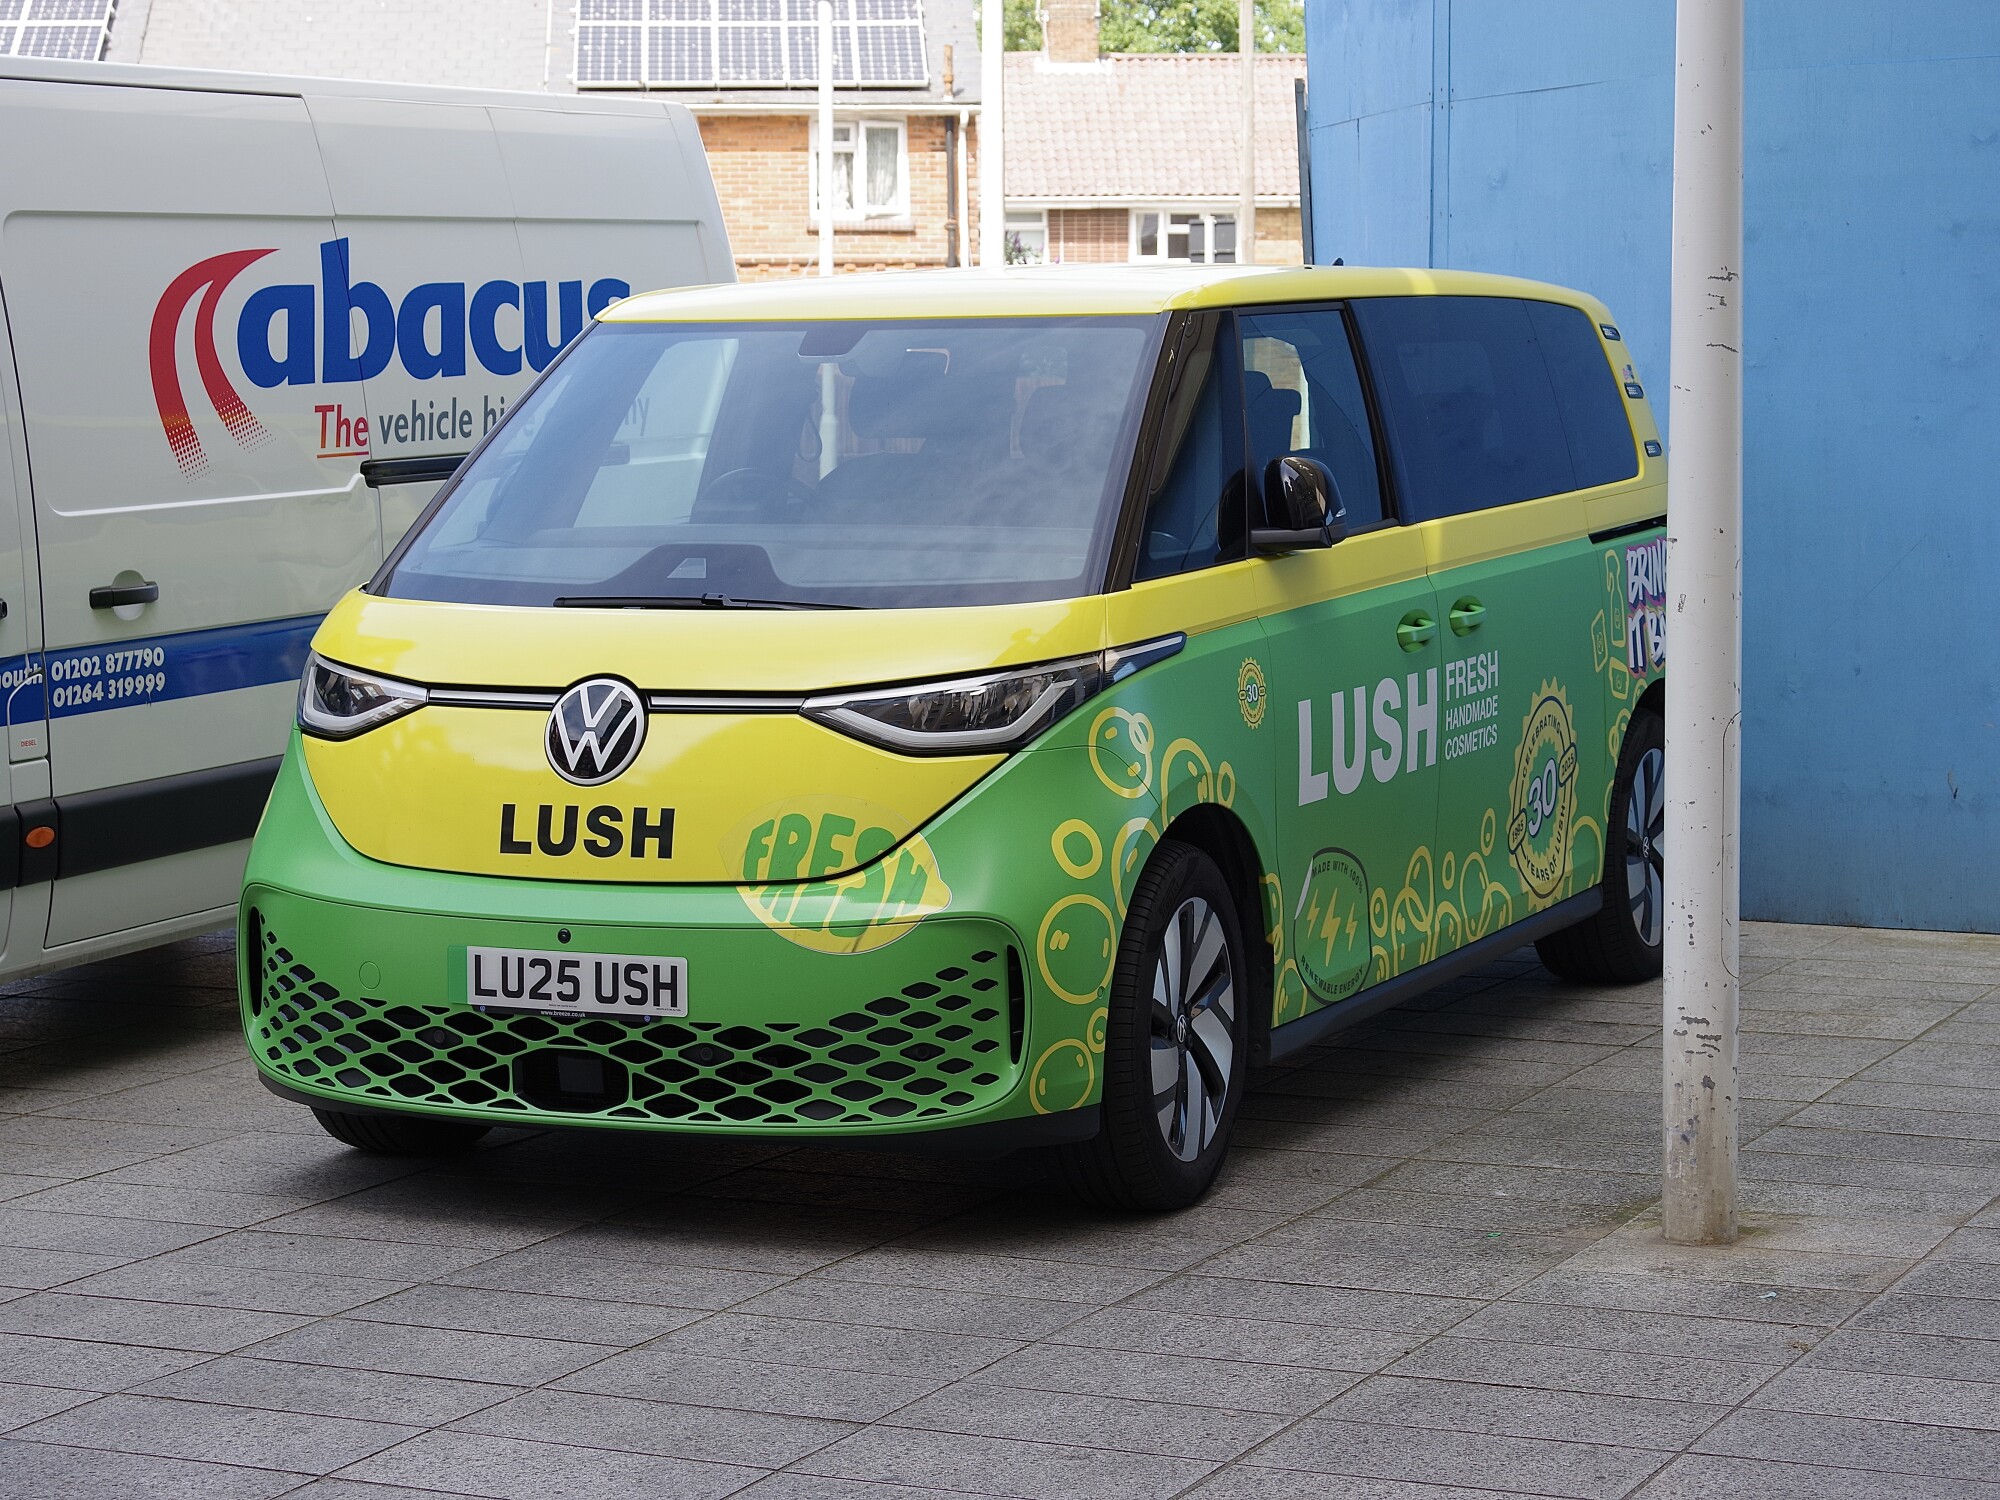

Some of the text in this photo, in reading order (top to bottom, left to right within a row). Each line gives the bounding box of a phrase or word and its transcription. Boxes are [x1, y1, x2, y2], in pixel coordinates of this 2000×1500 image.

[315, 404, 368, 449] The
[379, 397, 472, 444] vehicle
[0, 647, 165, 688] outh 01202 877790
[53, 672, 166, 708] 01264 319999
[1445, 650, 1499, 701] FRESH
[1246, 683, 1258, 703] 30
[1445, 695, 1498, 731] HANDMADE
[20, 739, 37, 747] DIESEL
[1298, 667, 1438, 807] LUSH
[1445, 724, 1498, 760] COSMETICS
[1522, 714, 1561, 777] CELEBRATING
[1528, 757, 1557, 837] 30
[500, 803, 676, 860] LUSH
[1512, 819, 1524, 844] 1995
[1525, 804, 1566, 882] YEARS OF LUSH
[742, 812, 929, 938] FRESH
[1312, 860, 1331, 878] MADE
[1332, 860, 1349, 875] WITH
[474, 954, 678, 1008] LU25 USH
[1301, 954, 1364, 995] RENEWABLE ENERGY
